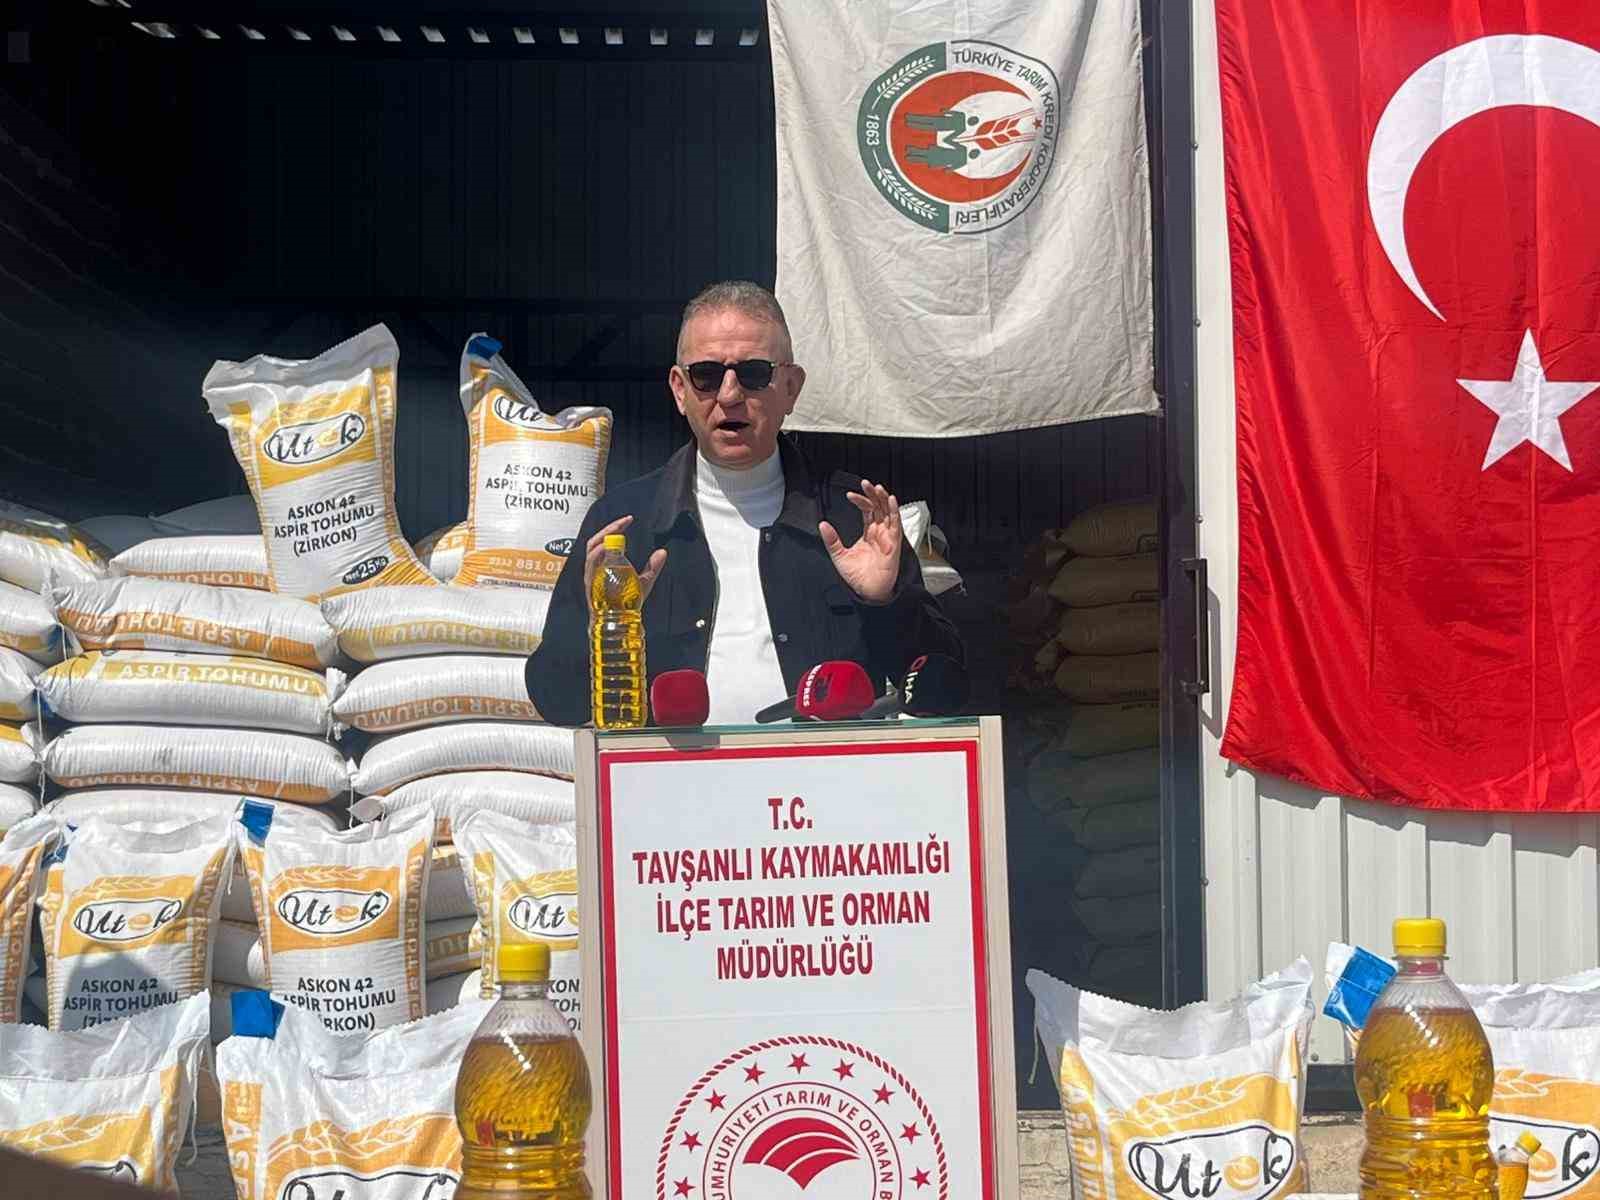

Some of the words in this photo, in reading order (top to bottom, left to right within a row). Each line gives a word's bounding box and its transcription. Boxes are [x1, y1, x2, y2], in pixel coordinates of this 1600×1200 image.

[953, 50, 1013, 73] TÜRKİYE
[1016, 65, 1049, 92] TARIM
[865, 113, 880, 147] 1863
[1040, 91, 1055, 142] KREDİ
[955, 143, 1050, 226] KOOPERATİFLERİ
[526, 481, 588, 497] TOHUMU
[555, 470, 572, 482] 42
[287, 497, 337, 521] ASKON
[339, 495, 356, 509] 42
[504, 493, 570, 514] (ZİRKON)
[274, 520, 309, 539] ASPİR
[311, 504, 375, 533] TOHUMU
[293, 526, 357, 557] (ZİRKON)
[183, 623, 250, 646] ASPİR
[118, 664, 192, 681] ASPİR
[198, 666, 309, 693] TOHUMU
[353, 698, 462, 728] TOHUMU
[768, 796, 813, 830] T.C.
[632, 848, 752, 891] TAVŞANLI
[761, 833, 950, 880] KAYMAKAMLIĞI
[657, 892, 711, 941] İLÇE
[718, 895, 795, 930] TARIM
[802, 894, 834, 927] VE
[842, 891, 930, 925] ORMAN
[717, 935, 873, 980] MÜDÜRLÜĞÜ
[81, 979, 134, 993] ASKON
[139, 978, 158, 993] 42
[298, 977, 350, 993] ASKON
[355, 977, 374, 993] 42
[64, 994, 101, 1011] ASPİR
[106, 992, 178, 1012] TOHUMU
[323, 989, 396, 1013] TOHUMU
[552, 998, 581, 1013] TOH
[711, 1097, 770, 1200] UMHURİYETİ
[773, 1090, 832, 1108] TARIM
[838, 1099, 859, 1120] VE
[859, 1119, 894, 1183] ORMAN
